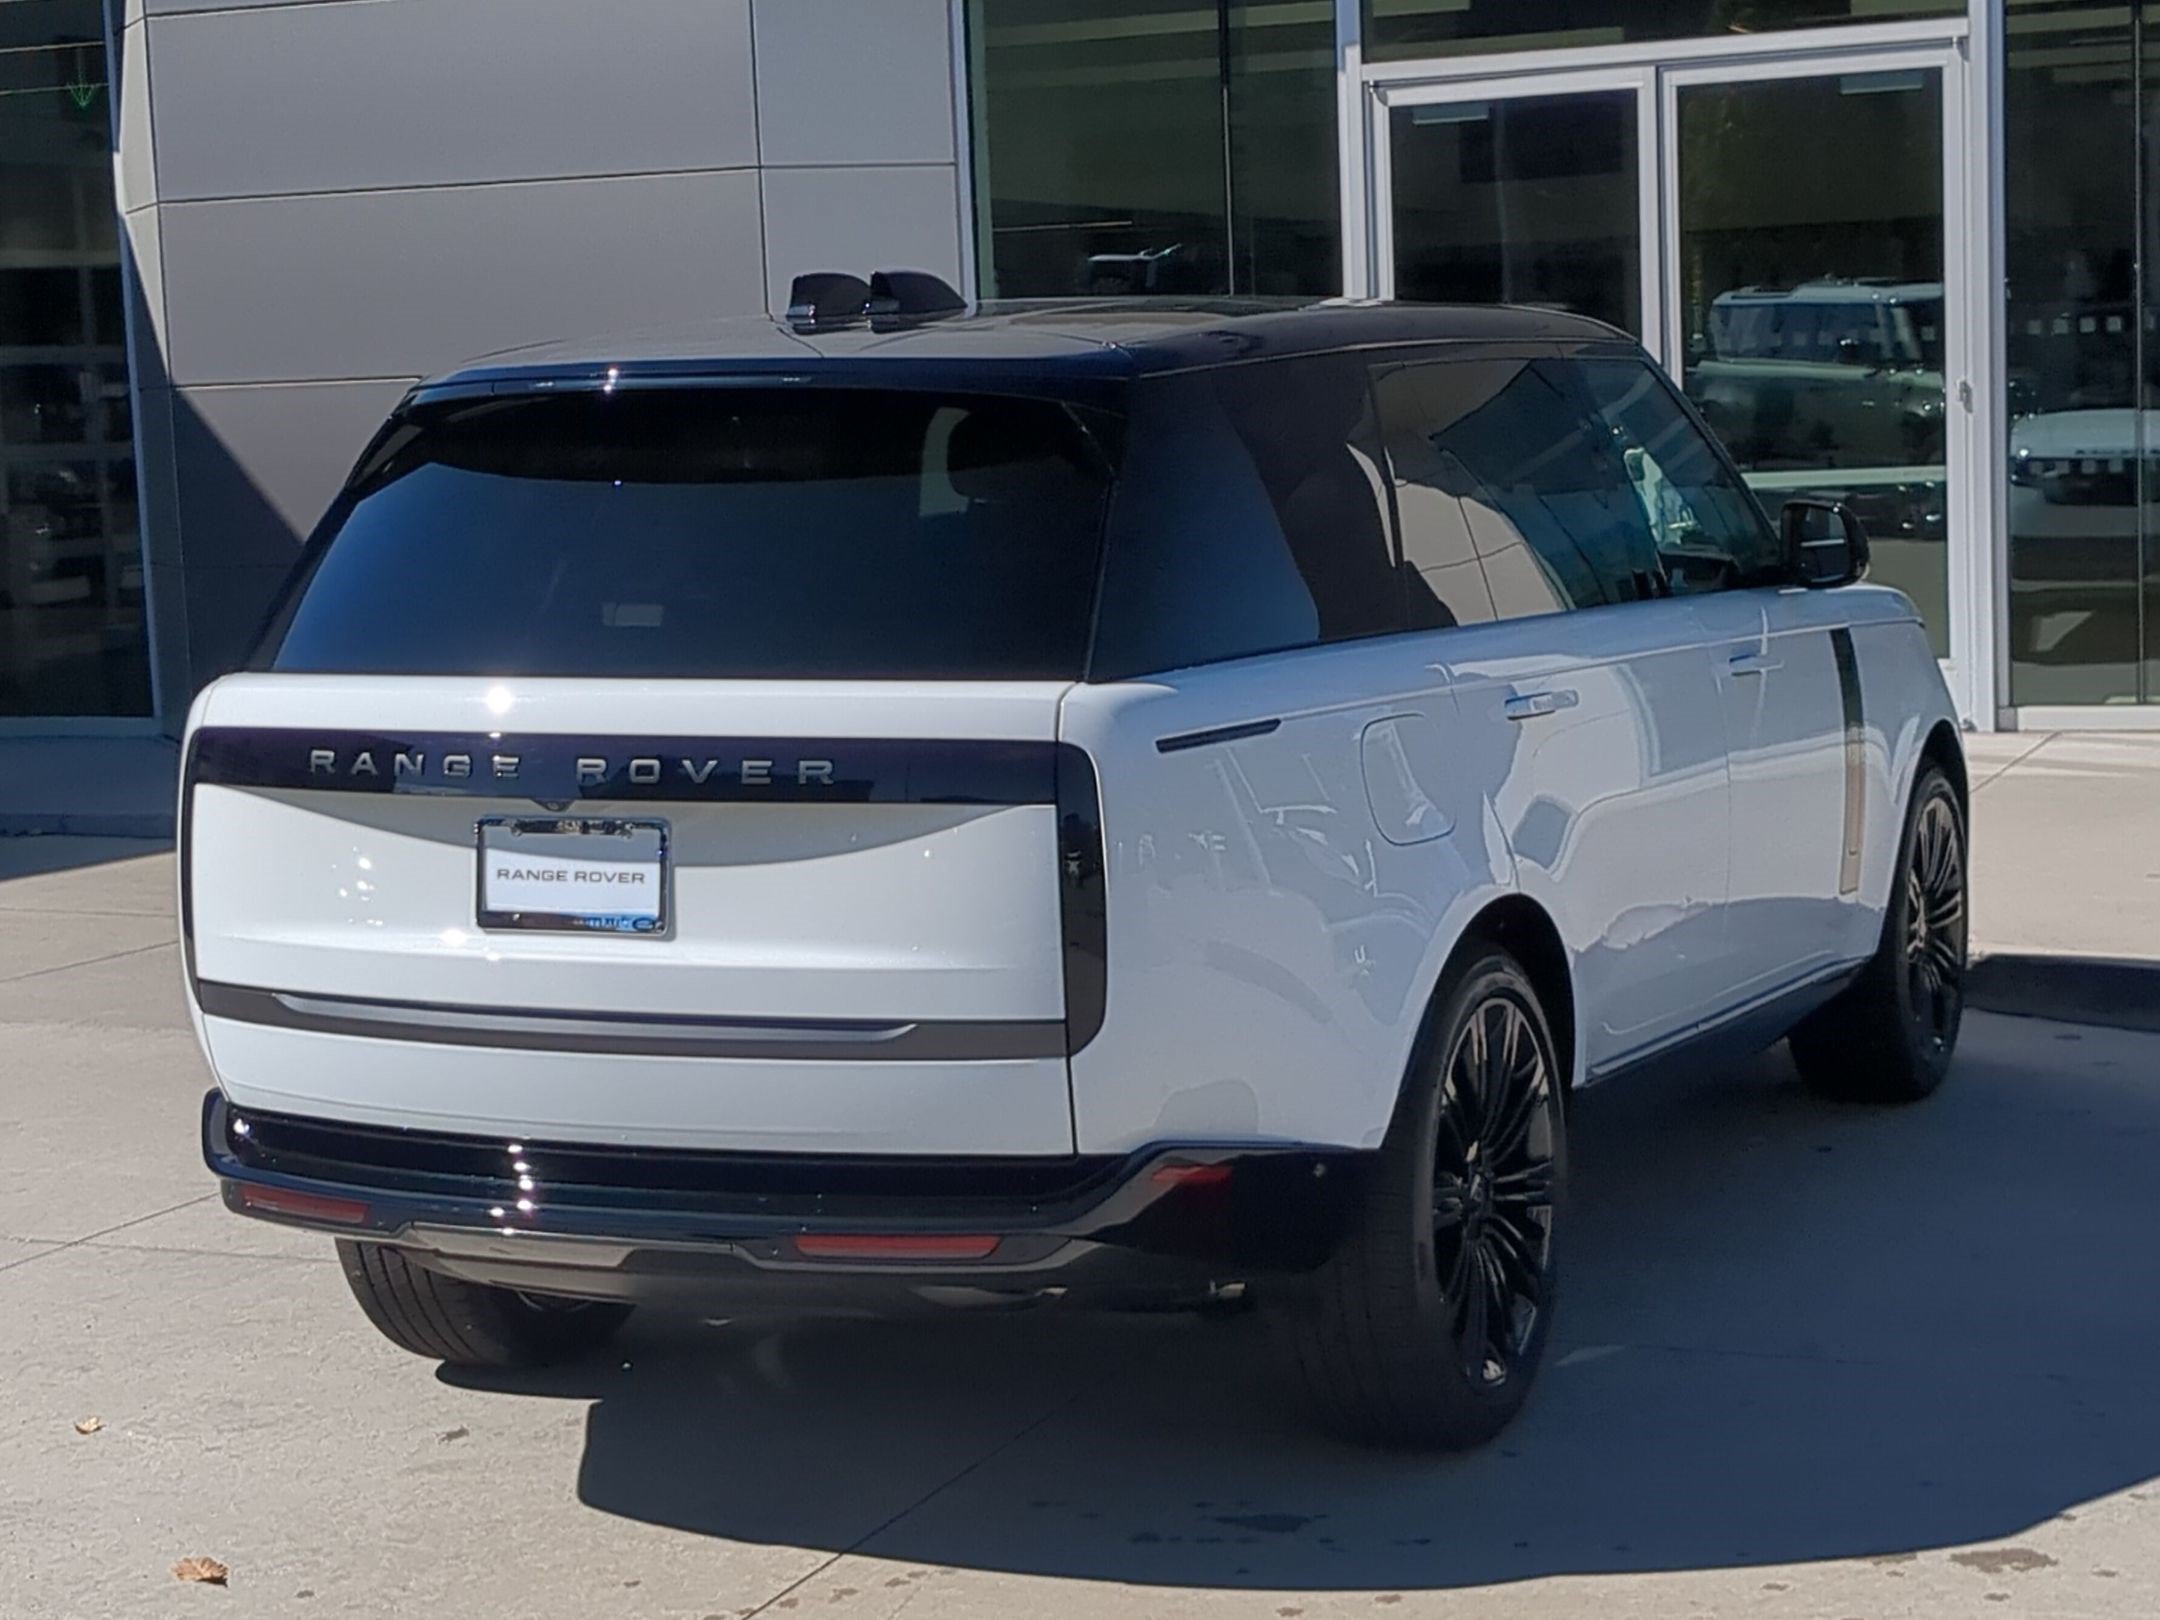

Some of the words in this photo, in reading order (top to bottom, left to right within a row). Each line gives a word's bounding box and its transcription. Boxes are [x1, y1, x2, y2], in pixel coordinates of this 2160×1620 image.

[309, 749, 520, 778] RANGE
[575, 757, 835, 784] ROVER
[496, 868, 568, 882] RANGE
[574, 870, 645, 884] ROVER
